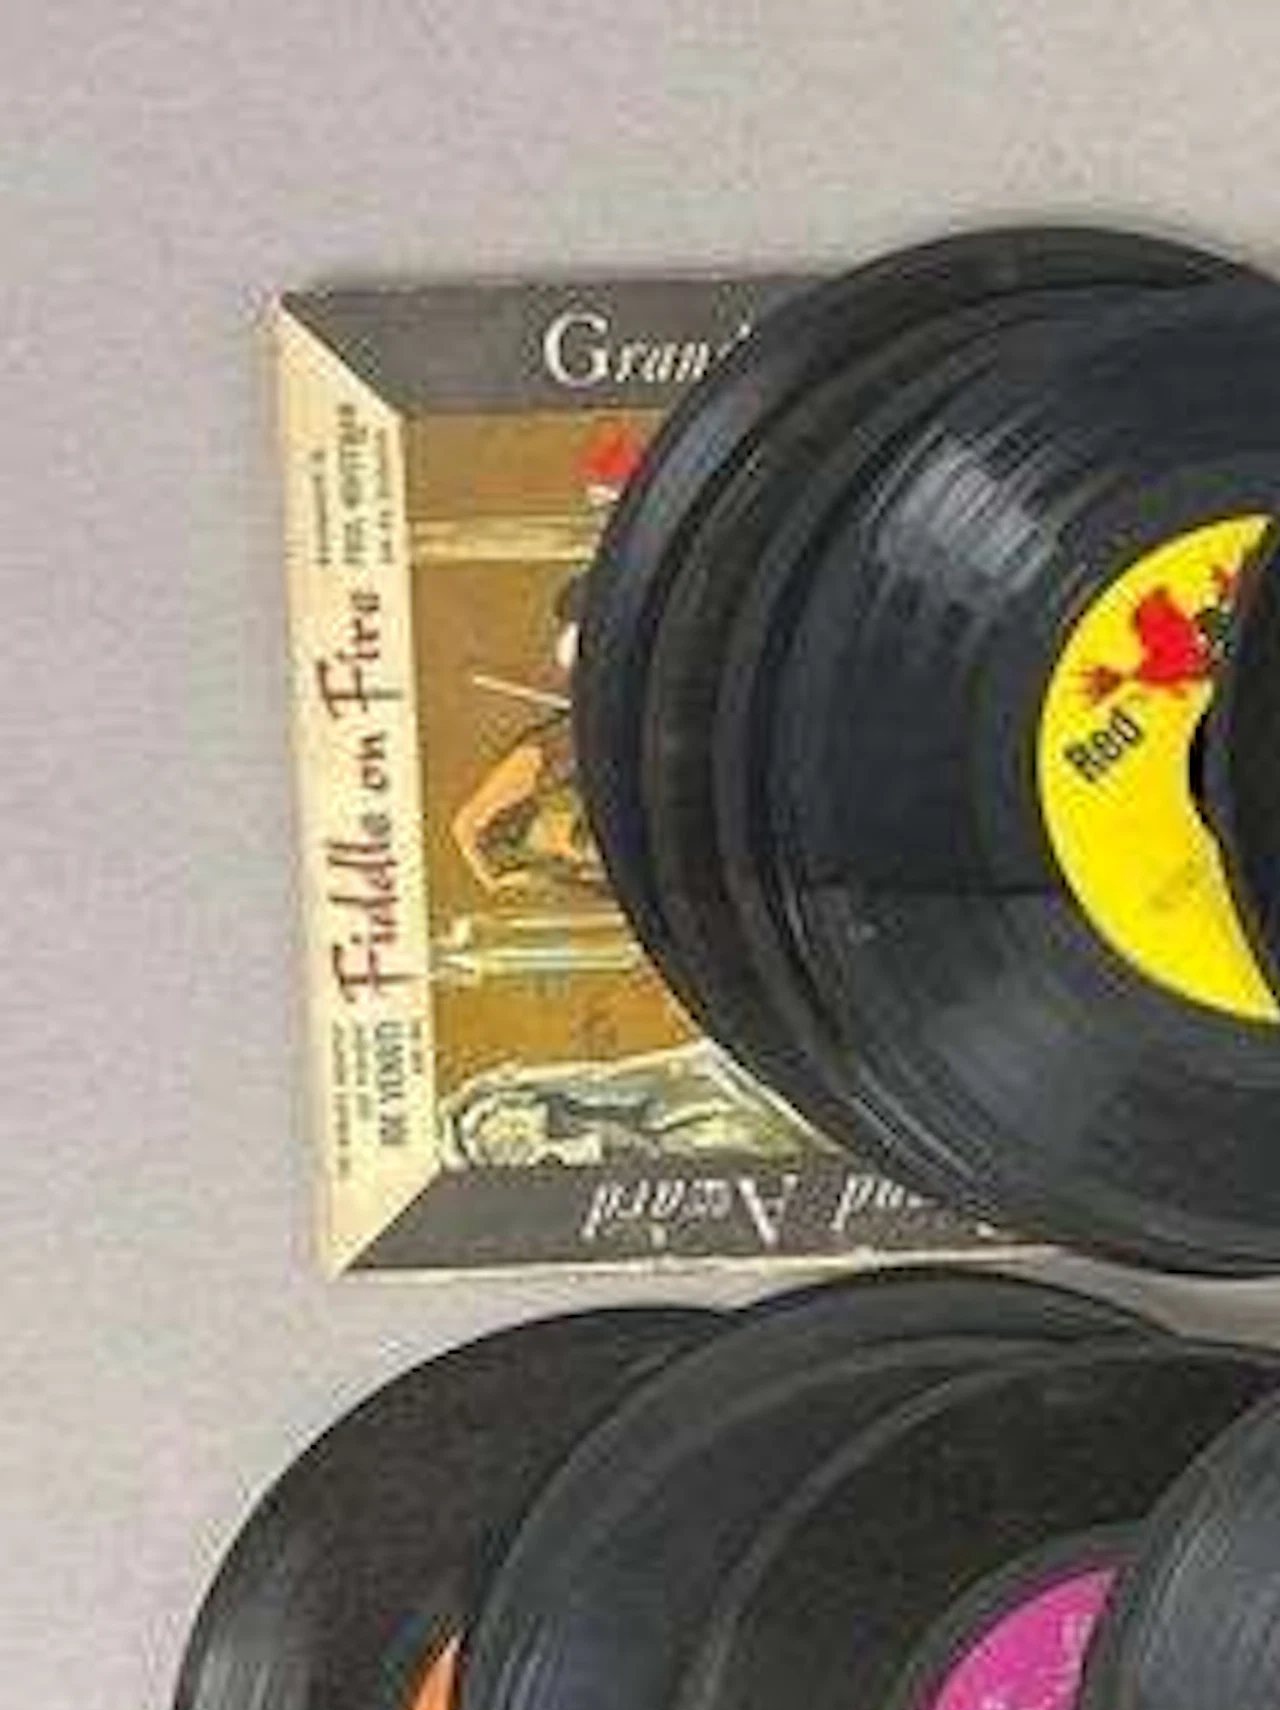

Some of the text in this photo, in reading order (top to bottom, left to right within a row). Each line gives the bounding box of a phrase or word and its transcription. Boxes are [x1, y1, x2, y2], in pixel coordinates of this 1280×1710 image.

[317, 590, 418, 1003] Fiddle on Fire
[578, 1173, 801, 1246] Award
